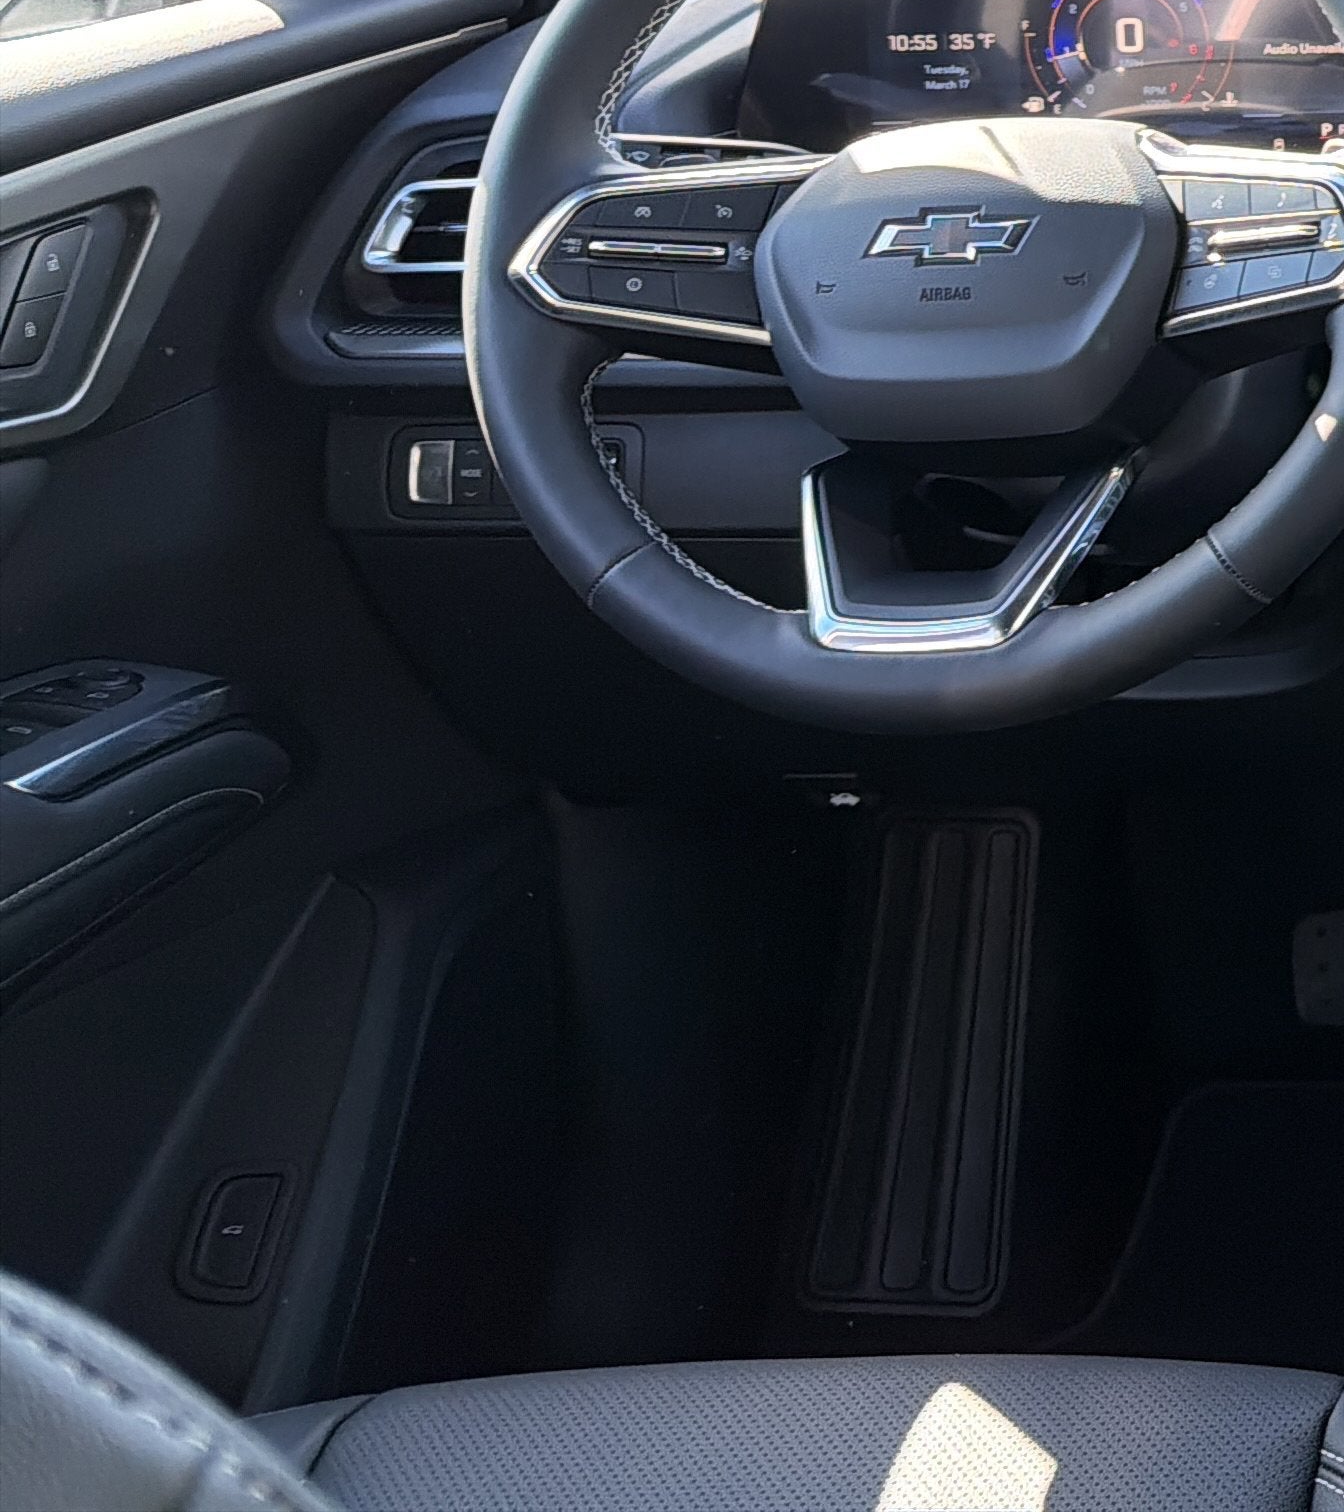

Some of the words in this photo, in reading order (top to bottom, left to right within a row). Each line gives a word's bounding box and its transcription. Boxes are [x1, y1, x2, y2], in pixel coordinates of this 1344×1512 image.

[1115, 17, 1144, 53] 0
[887, 34, 938, 52] 10:55
[949, 33, 975, 51] 35
[1263, 43, 1298, 56] Audio
[923, 64, 970, 76] Tuesday,
[925, 80, 957, 90] March
[1320, 122, 1333, 136] P
[919, 287, 972, 302] AIRBAG
